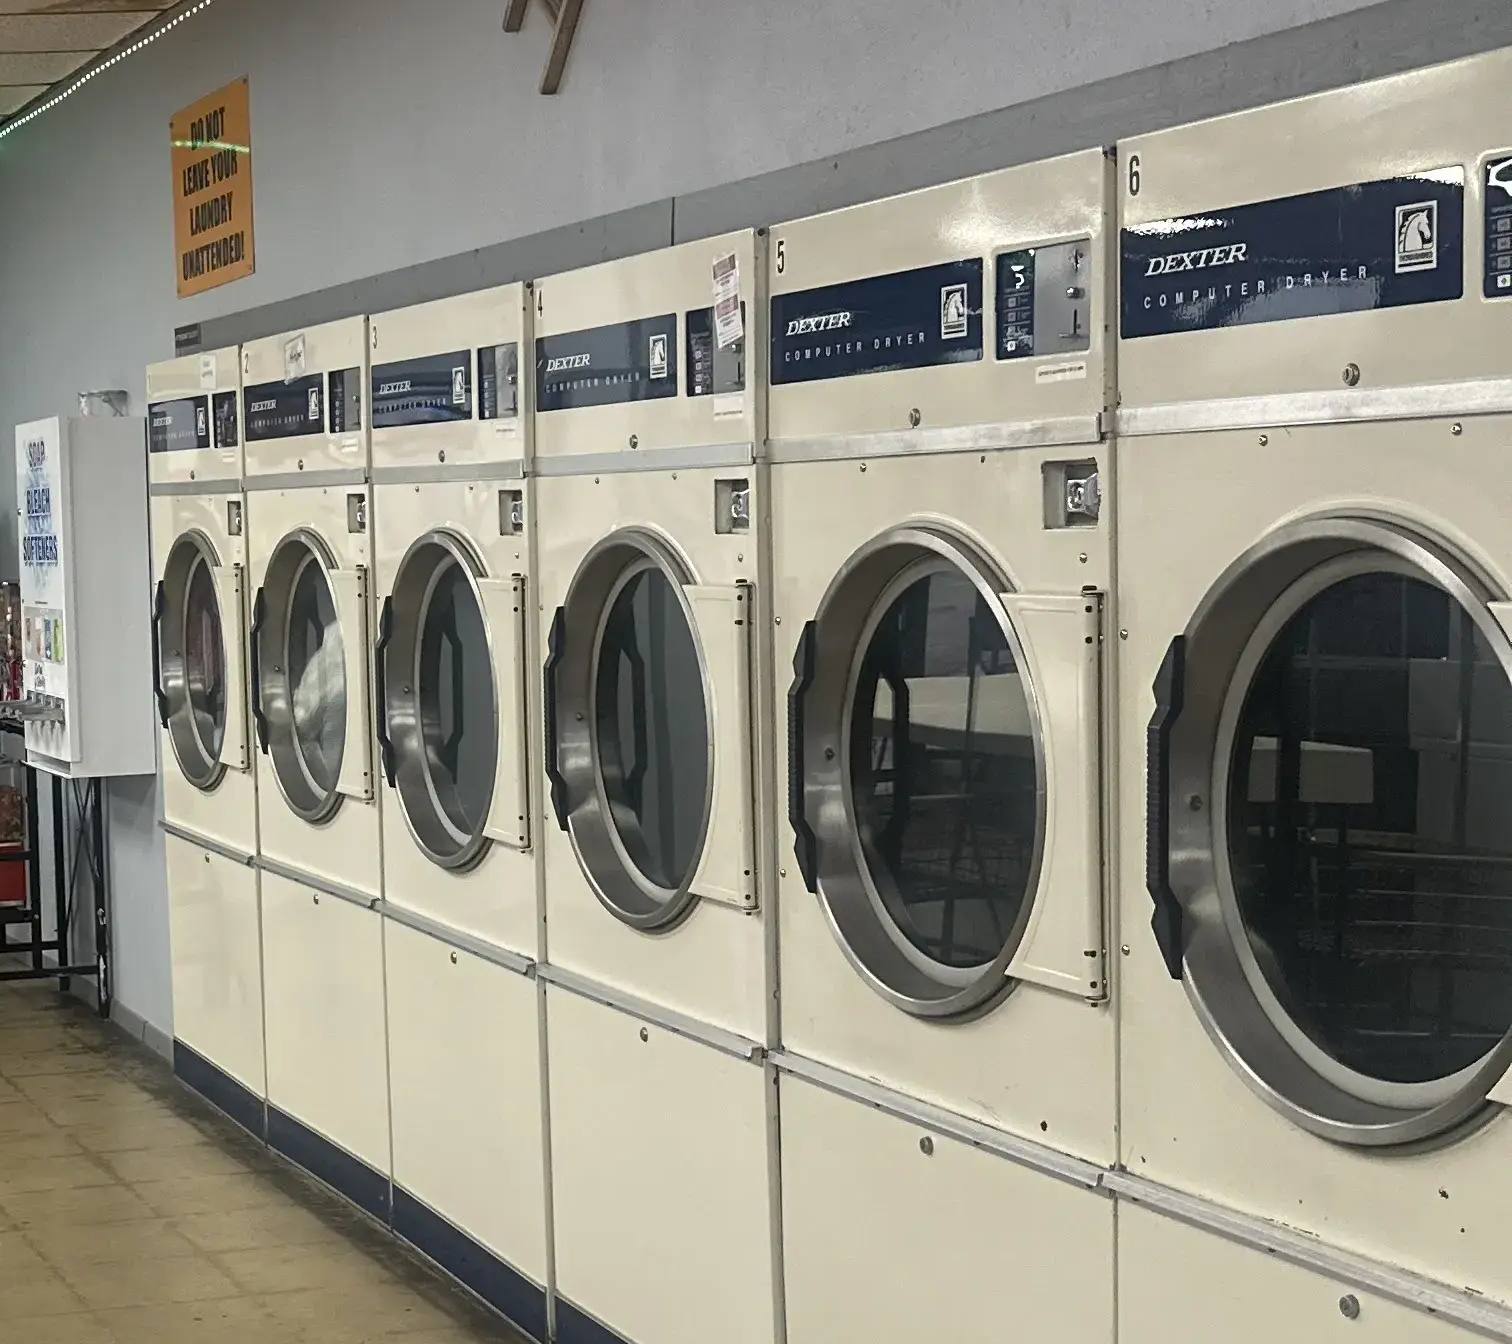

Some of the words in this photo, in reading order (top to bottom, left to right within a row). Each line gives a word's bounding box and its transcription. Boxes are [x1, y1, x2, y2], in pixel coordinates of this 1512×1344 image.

[190, 116, 204, 151] DO
[205, 106, 226, 142] NOT
[183, 158, 210, 197] LEAVE
[211, 147, 238, 184] YOUR
[1129, 155, 1140, 196] 6
[190, 191, 234, 236] LAUNDRY
[182, 230, 245, 281] UNATTENDED!
[777, 240, 785, 273] 5
[1144, 243, 1247, 276] DEXTER
[1144, 279, 1266, 309] COMPUTER
[1286, 265, 1368, 289] DRYER
[538, 290, 543, 317] 4
[373, 325, 378, 349] 3
[785, 311, 851, 336] DEXTER
[785, 342, 862, 362] COMPUTER
[874, 331, 925, 350] DRYER
[244, 353, 249, 374] 2
[546, 353, 591, 372] DEXTER
[379, 380, 412, 395] DEXTER
[545, 377, 599, 394] COMPUTER
[605, 372, 640, 386] DRYER
[250, 399, 277, 413] DEXTER
[28, 440, 45, 467] SOAP
[27, 487, 51, 515] BLEACH
[23, 535, 58, 562] SOFTENERS
